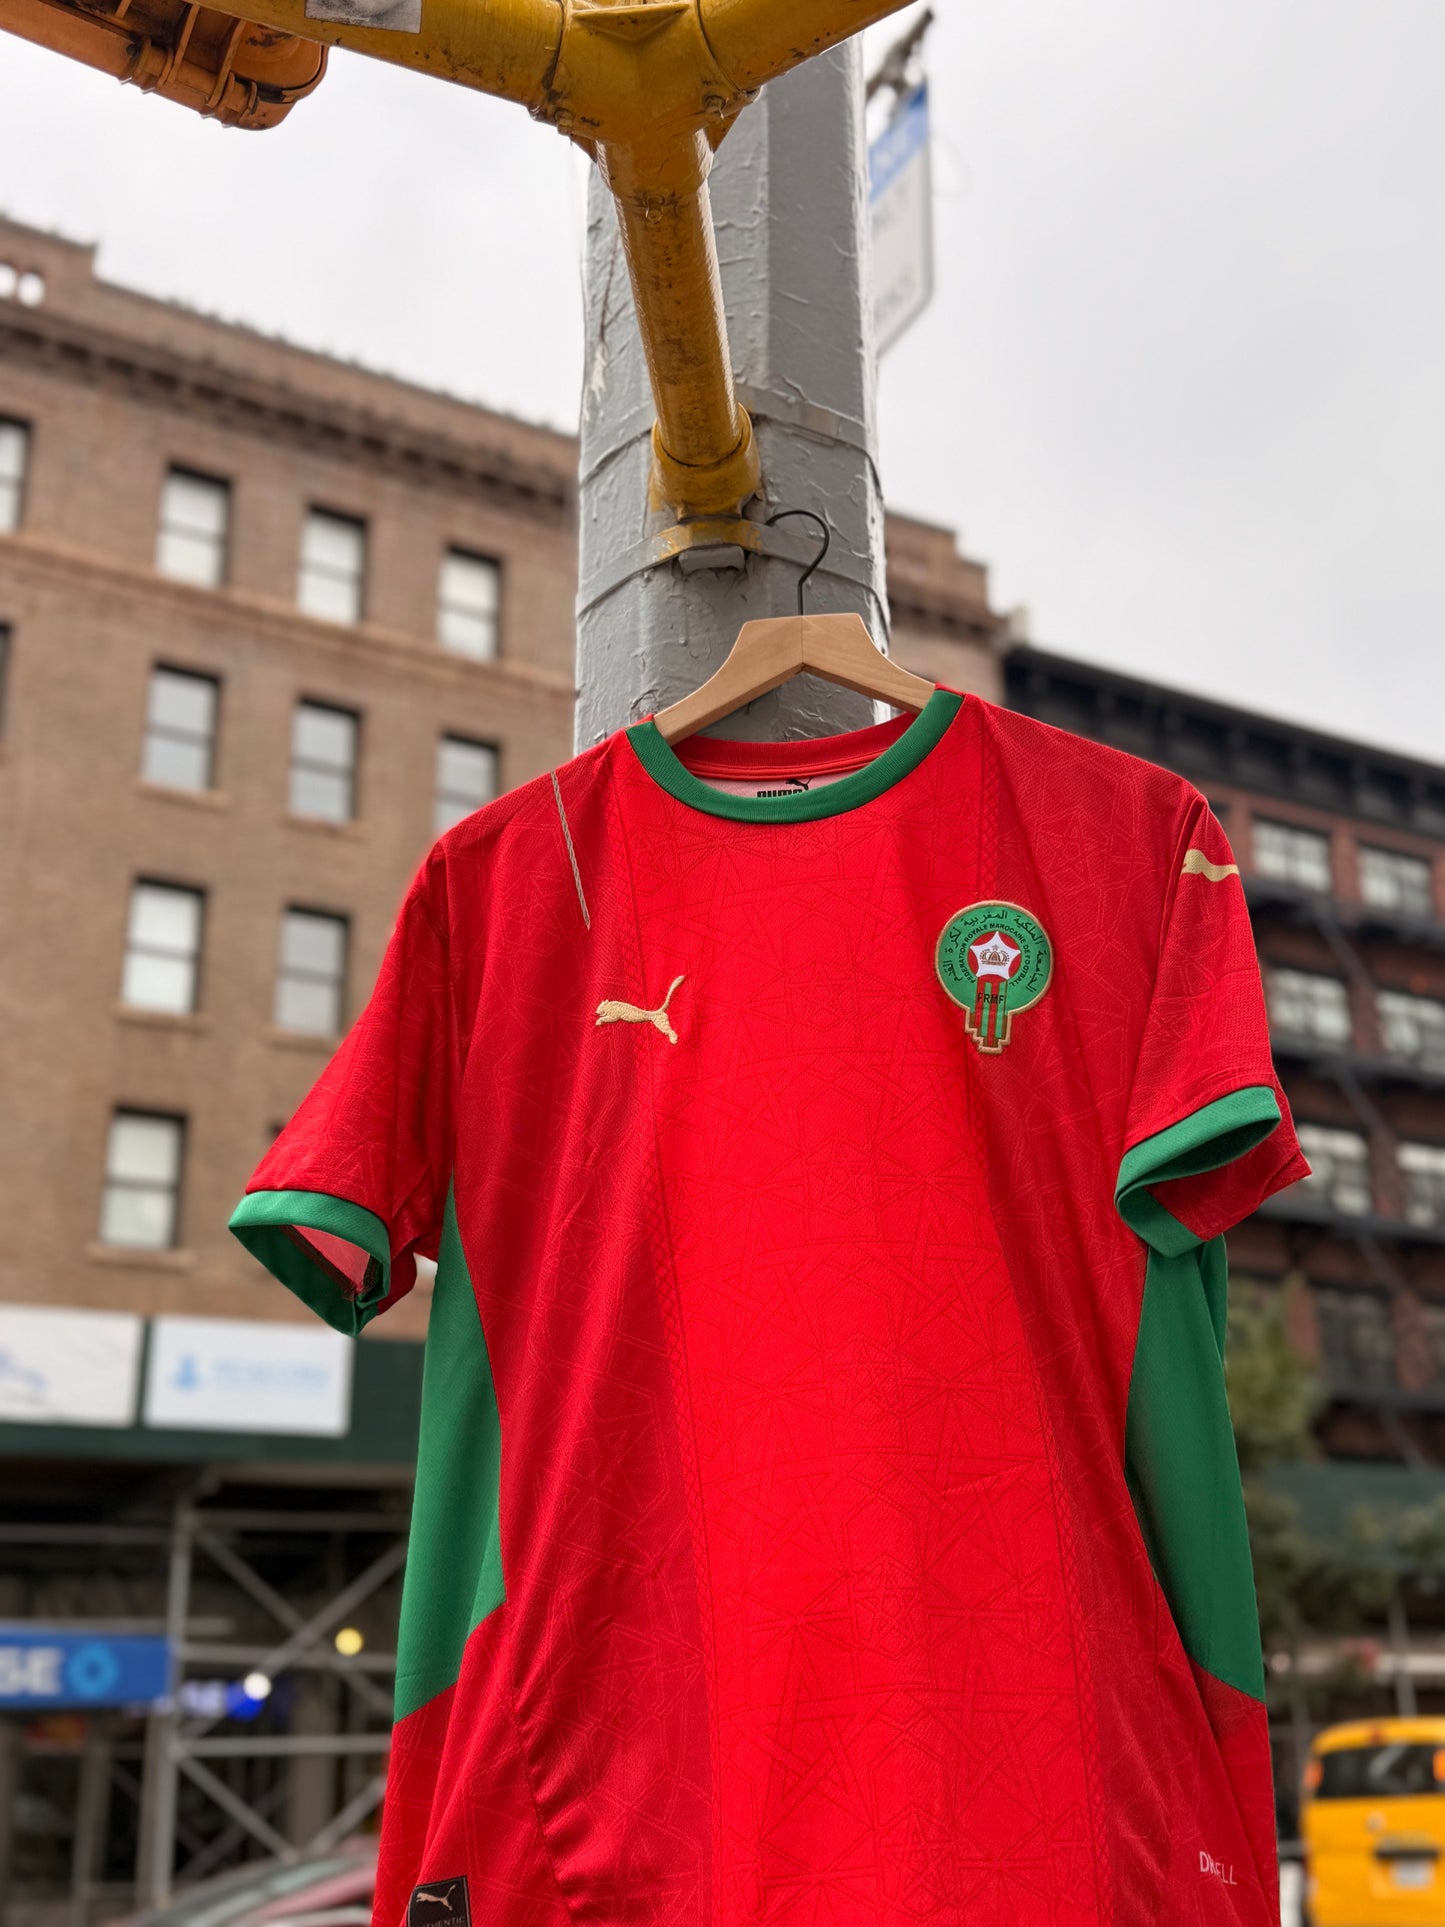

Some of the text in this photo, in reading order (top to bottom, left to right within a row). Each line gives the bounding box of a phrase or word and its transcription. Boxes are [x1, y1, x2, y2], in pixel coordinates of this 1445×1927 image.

[961, 909, 1008, 926] المغربية
[1013, 915, 1044, 945] الملكية
[945, 926, 962, 954] لكرة
[964, 924, 988, 943] ROYALE
[989, 922, 1026, 944] MAROCAINE
[959, 942, 977, 983] FEDERATION
[1009, 956, 1031, 987] FOOTBALL
[1025, 949, 1047, 993] الجامعة
[976, 992, 1004, 1005] FRMF
